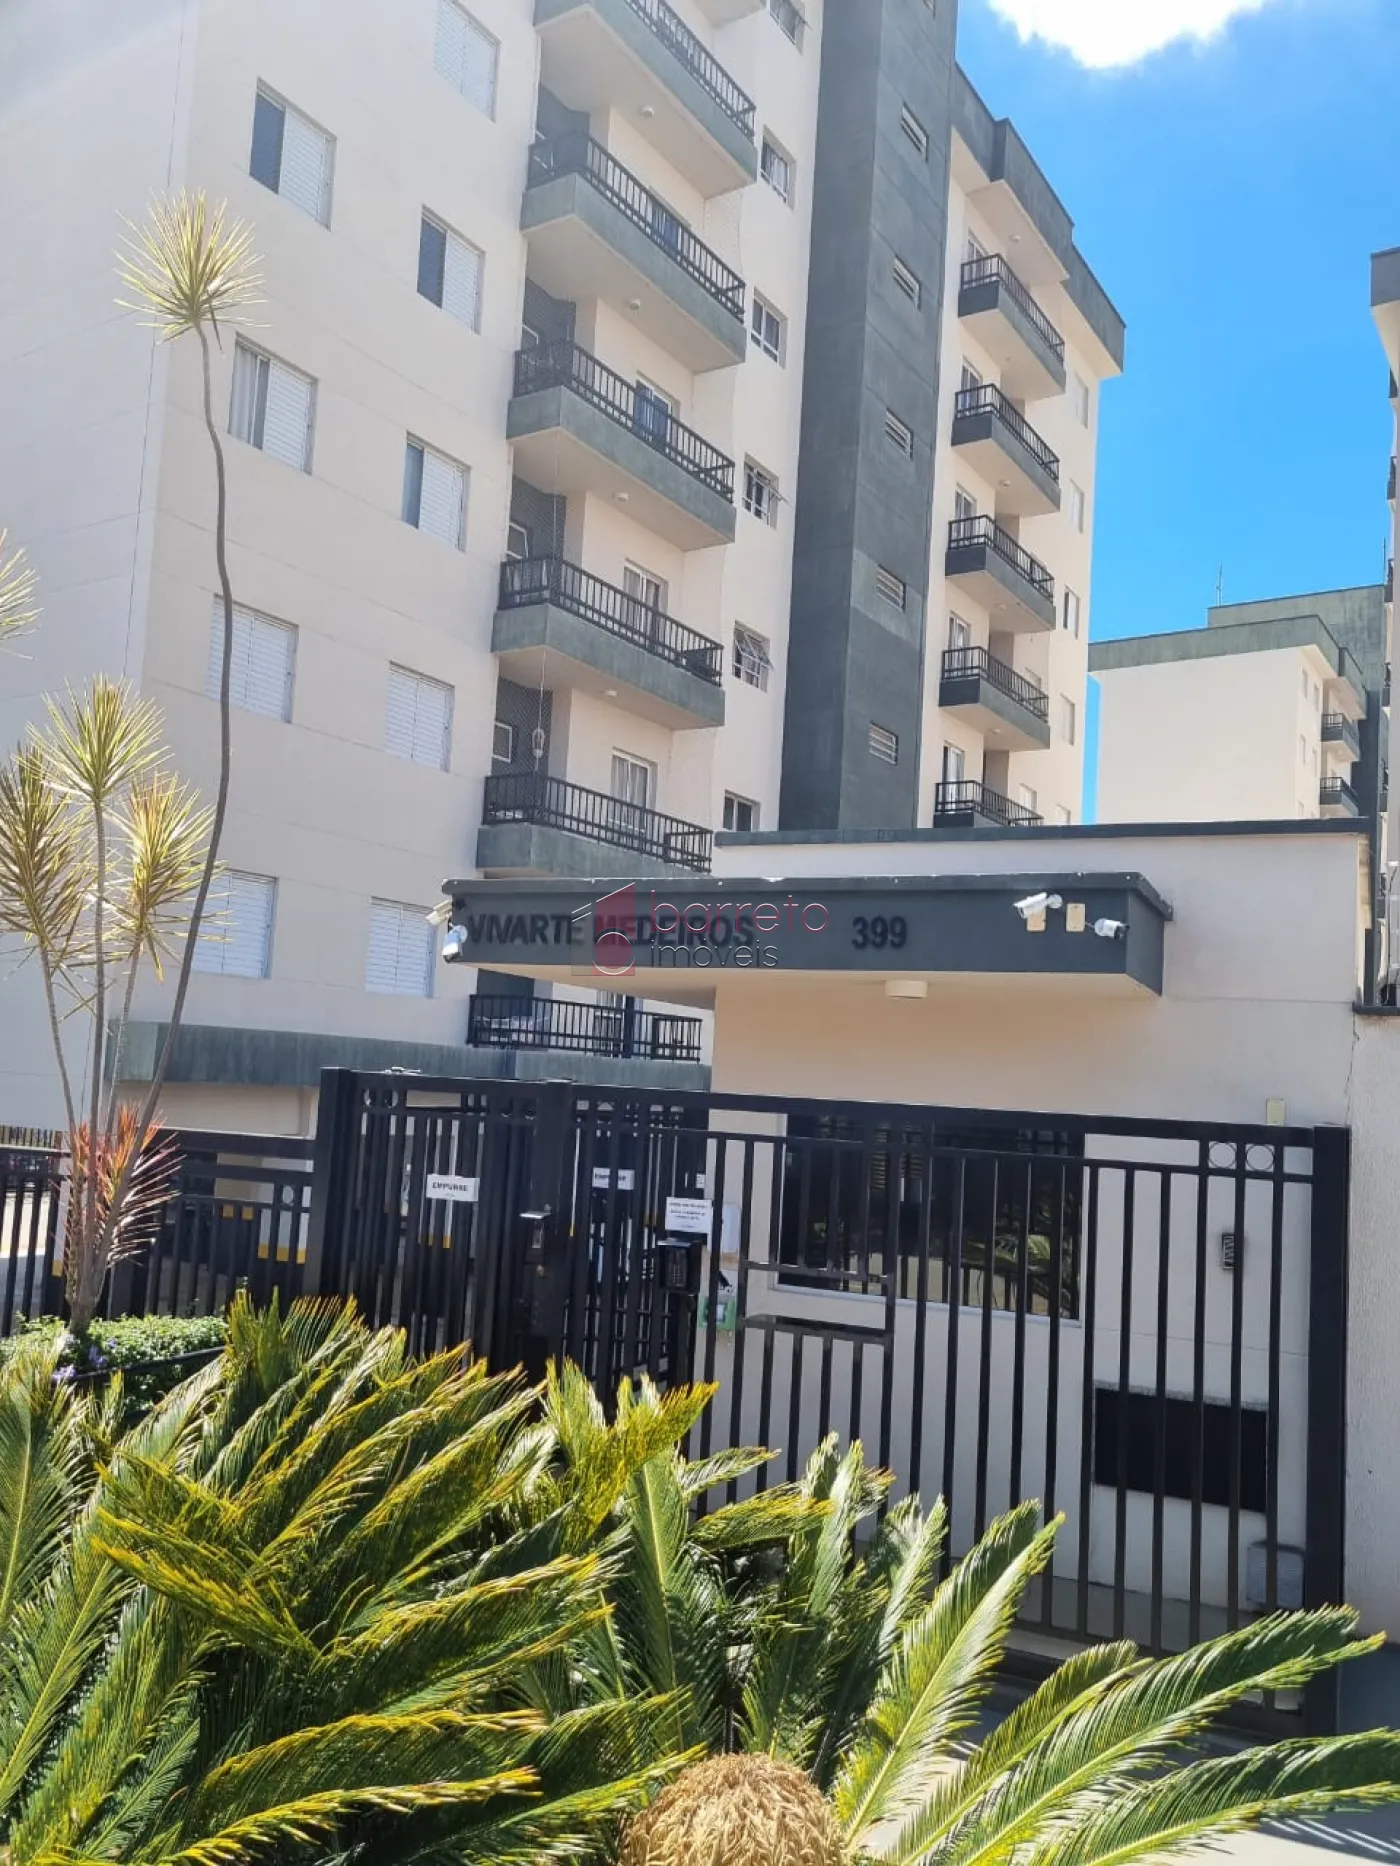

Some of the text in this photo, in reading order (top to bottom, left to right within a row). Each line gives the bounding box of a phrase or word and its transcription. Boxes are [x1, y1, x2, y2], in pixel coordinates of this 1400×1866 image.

[469, 913, 908, 949] VIVARTE MEDEIROS 399
